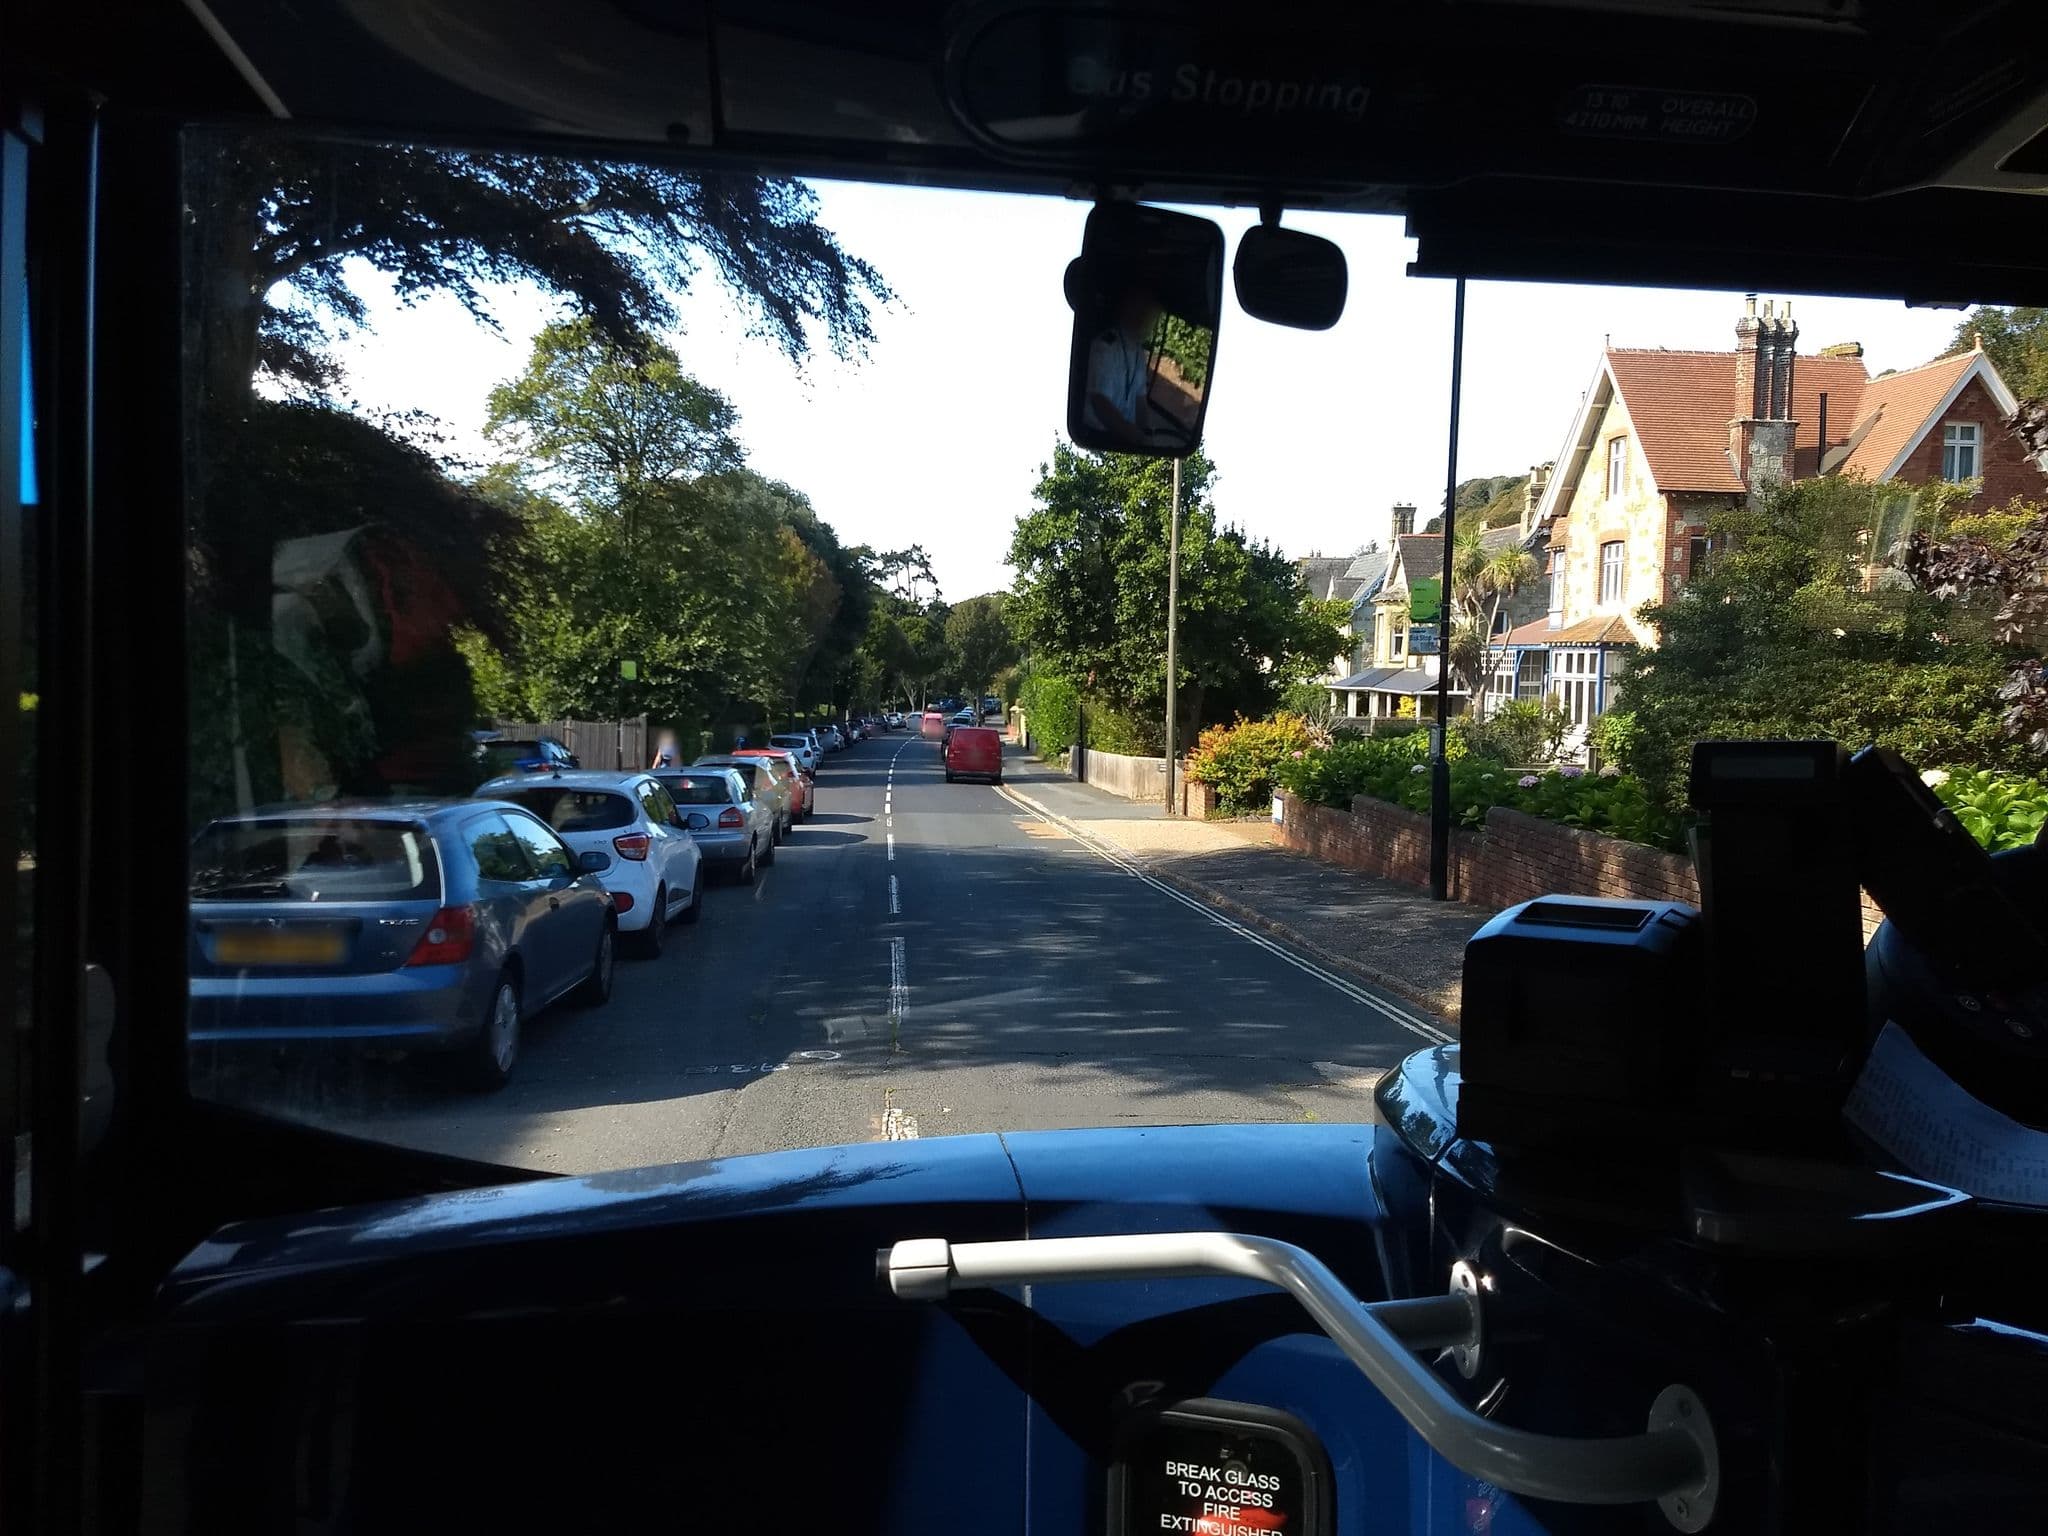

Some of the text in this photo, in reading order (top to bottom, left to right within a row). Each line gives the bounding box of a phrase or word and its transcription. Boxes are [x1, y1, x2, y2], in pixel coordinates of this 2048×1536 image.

[1171, 63, 1370, 119] Stopping
[1661, 97, 1745, 119] OVERALL
[1660, 118, 1736, 137] HEIGHT
[1166, 1461, 1280, 1491] BREAK GLASS
[1178, 1481, 1273, 1508] TO ACCESS
[1203, 1502, 1241, 1521] FIRE
